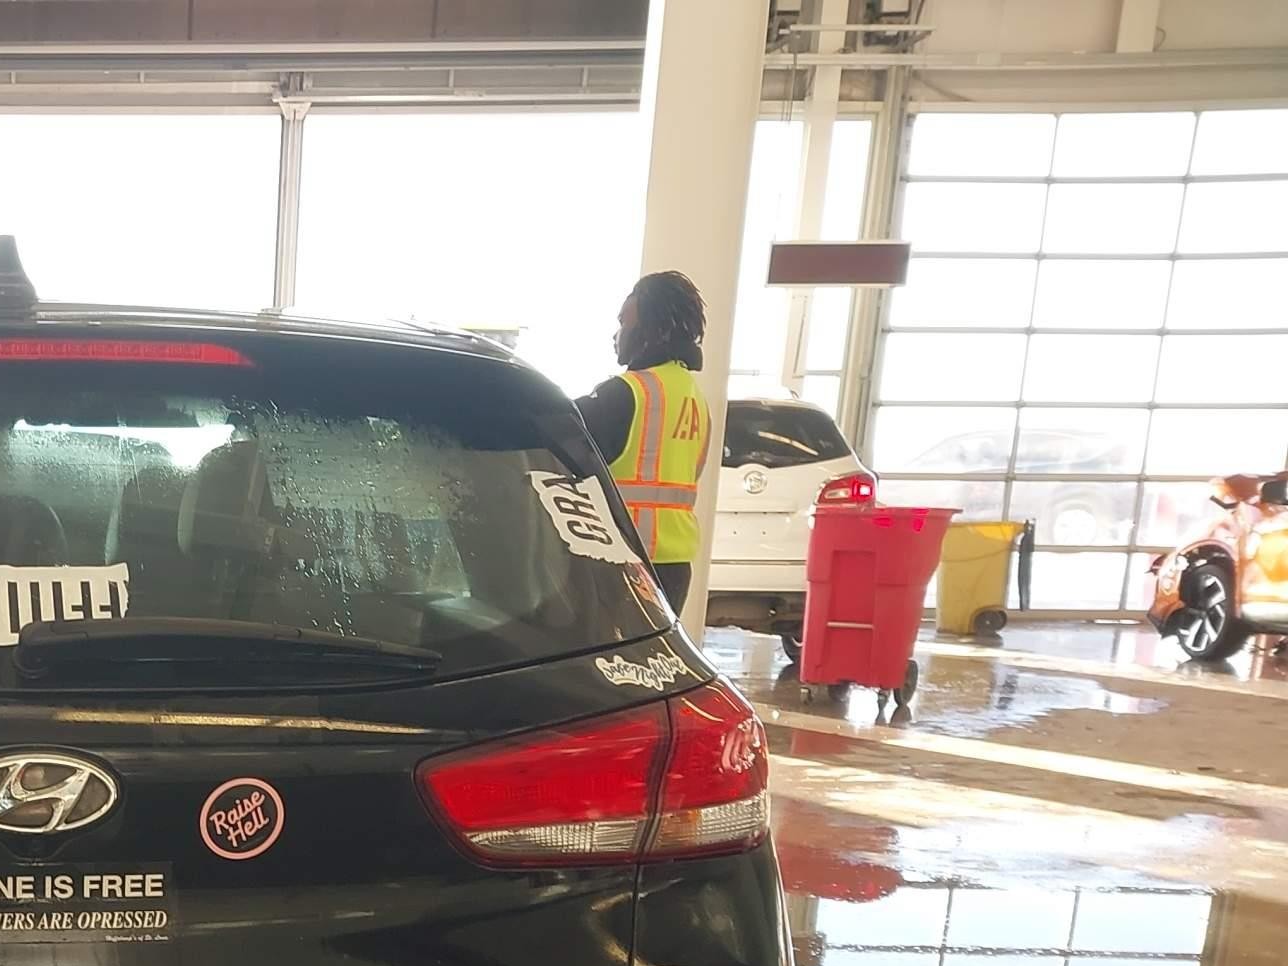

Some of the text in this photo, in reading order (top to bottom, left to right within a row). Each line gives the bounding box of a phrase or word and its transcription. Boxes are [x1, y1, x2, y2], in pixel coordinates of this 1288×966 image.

[209, 791, 270, 848] Raise Hell
[44, 874, 74, 899] IS
[83, 873, 165, 898] FREE
[37, 911, 73, 930] ARE
[77, 909, 168, 930] OPRESSED
